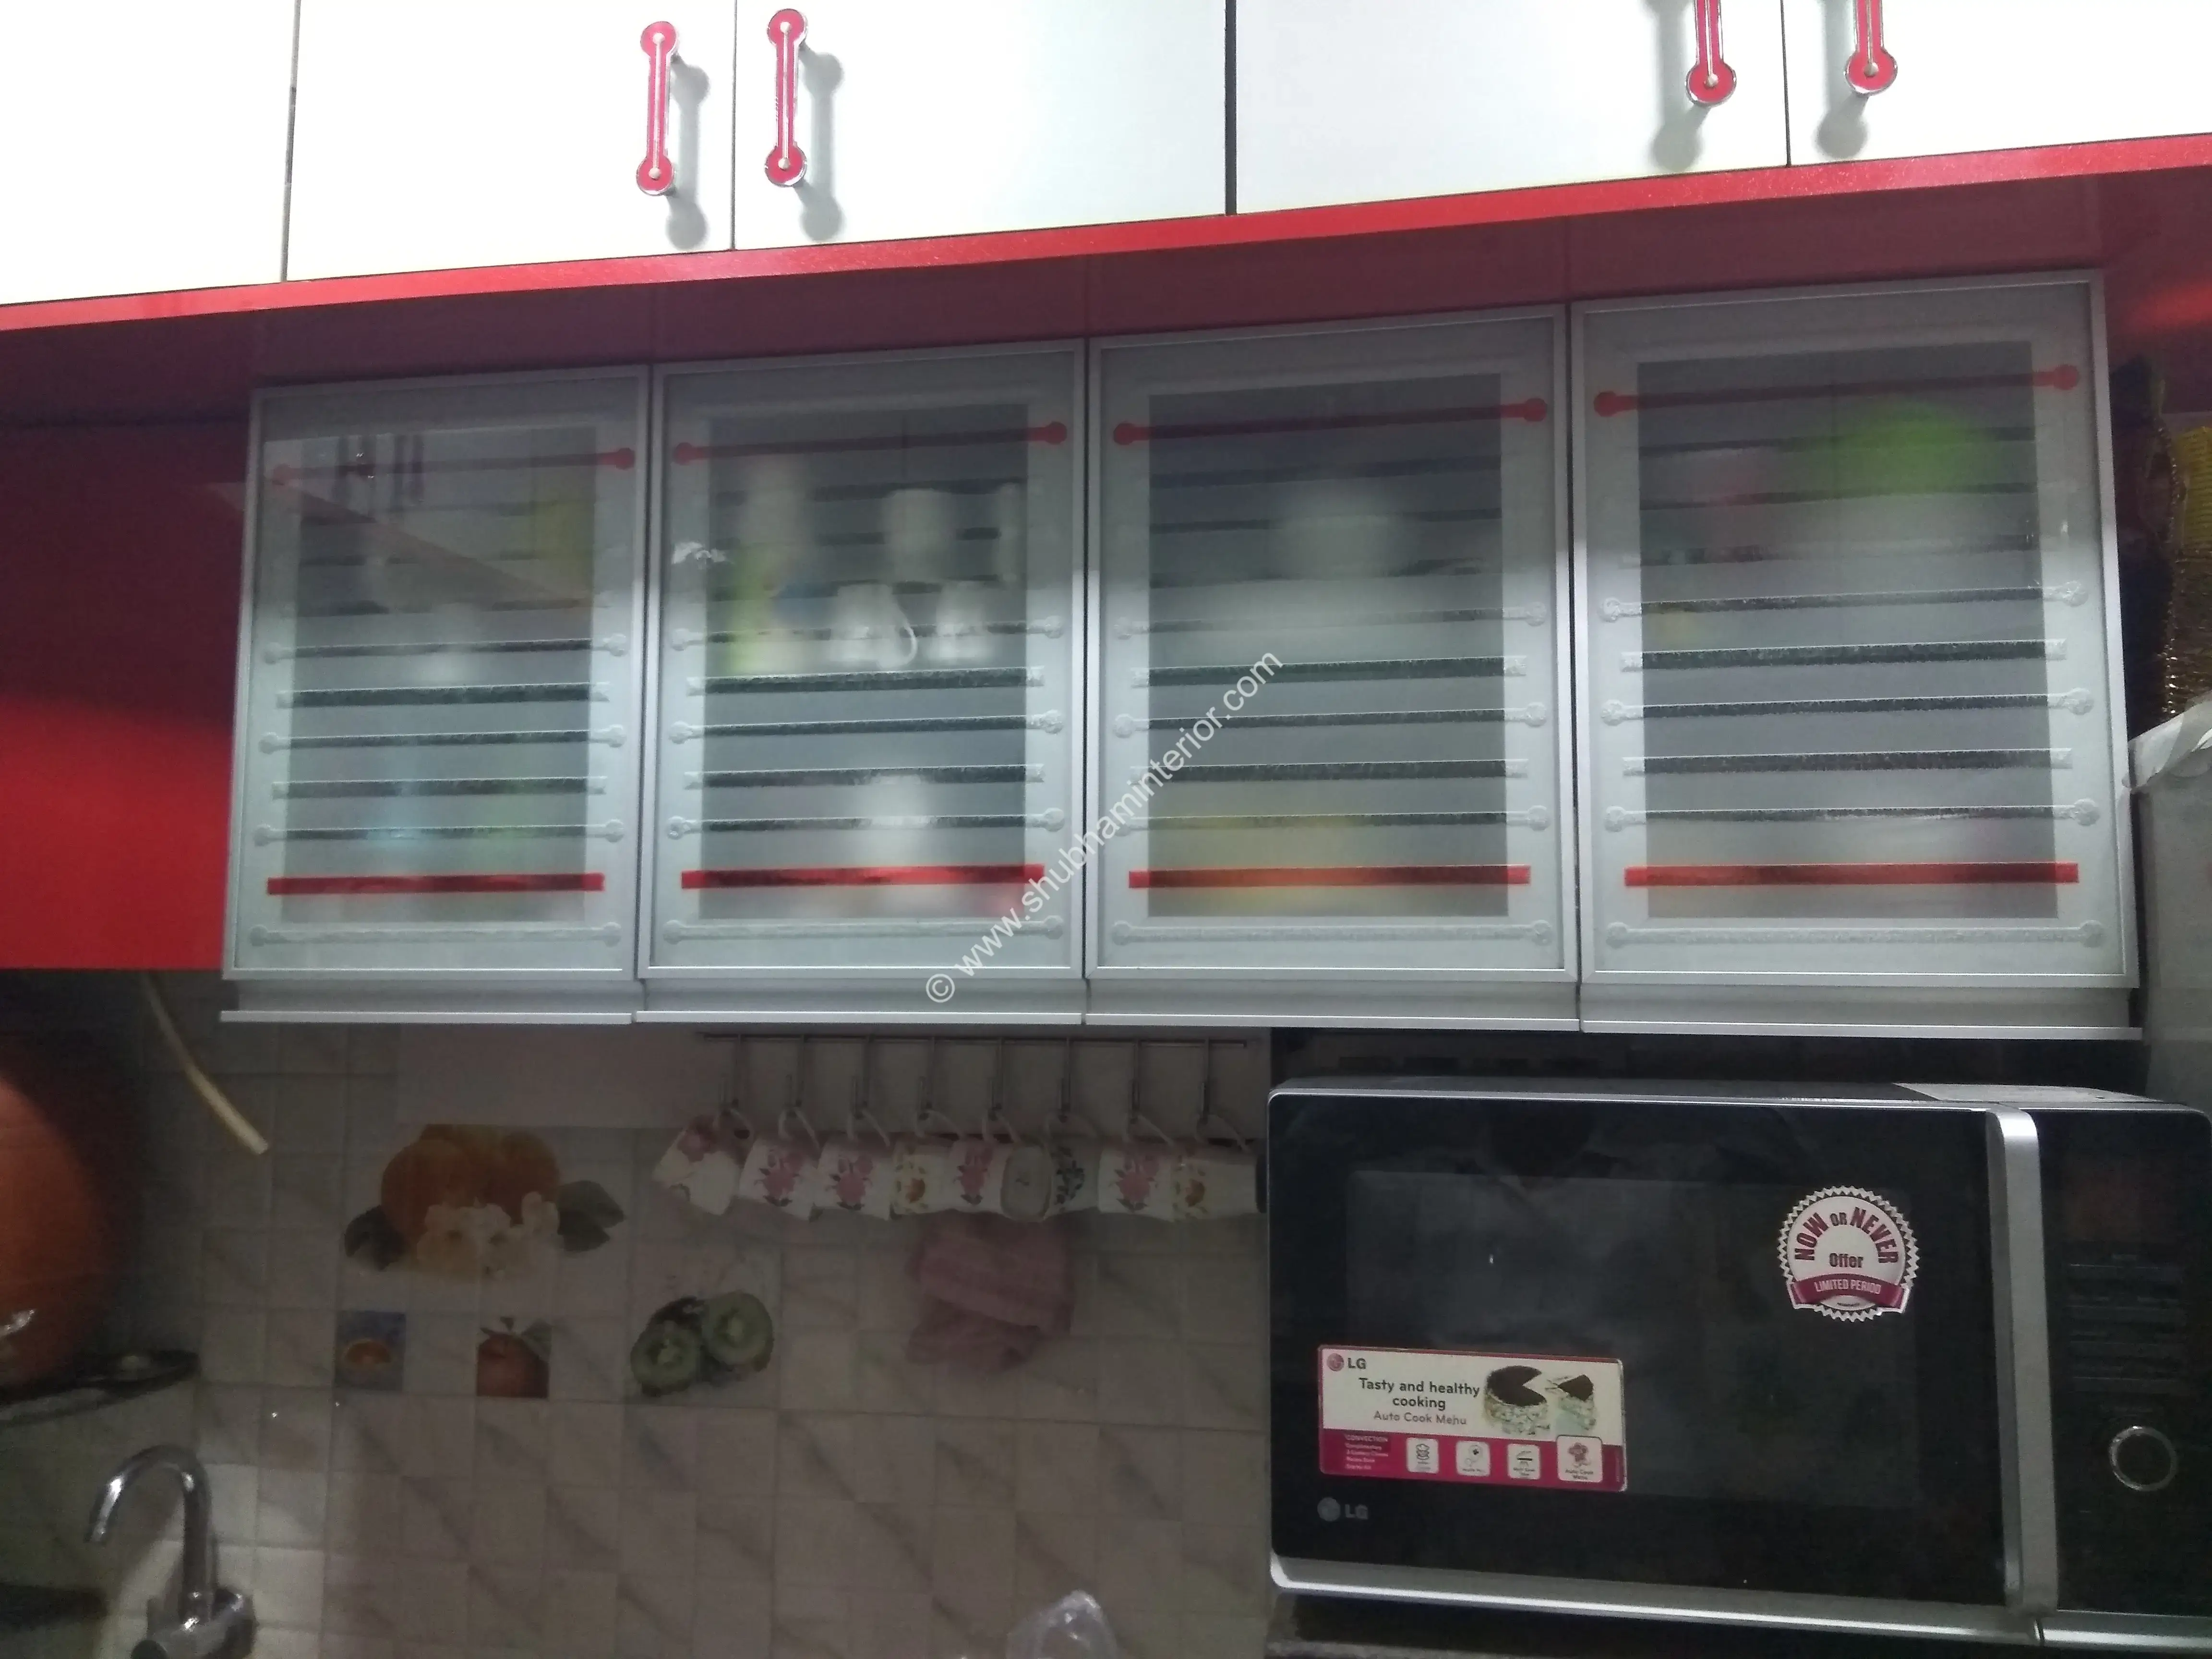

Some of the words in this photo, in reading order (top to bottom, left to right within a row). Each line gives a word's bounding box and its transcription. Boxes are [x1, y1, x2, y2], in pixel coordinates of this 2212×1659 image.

[1794, 1212, 1829, 1261] NOW
[1829, 1212, 1848, 1226] OR
[1850, 1206, 1899, 1264] NEVER
[1829, 1252, 1864, 1268] Offer
[1814, 1279, 1848, 1293] LIMITED
[1850, 1279, 1882, 1295] PERIOD
[1347, 1357, 1367, 1370] LG
[1358, 1377, 1394, 1393] Tasty
[1399, 1381, 1424, 1392] and
[1429, 1382, 1479, 1398] healthy
[1392, 1396, 1446, 1411] cooking
[1373, 1410, 1400, 1422] Auto
[1404, 1412, 1432, 1423] Cook
[1436, 1414, 1467, 1426] Menu
[1345, 1504, 1368, 1519] LG
